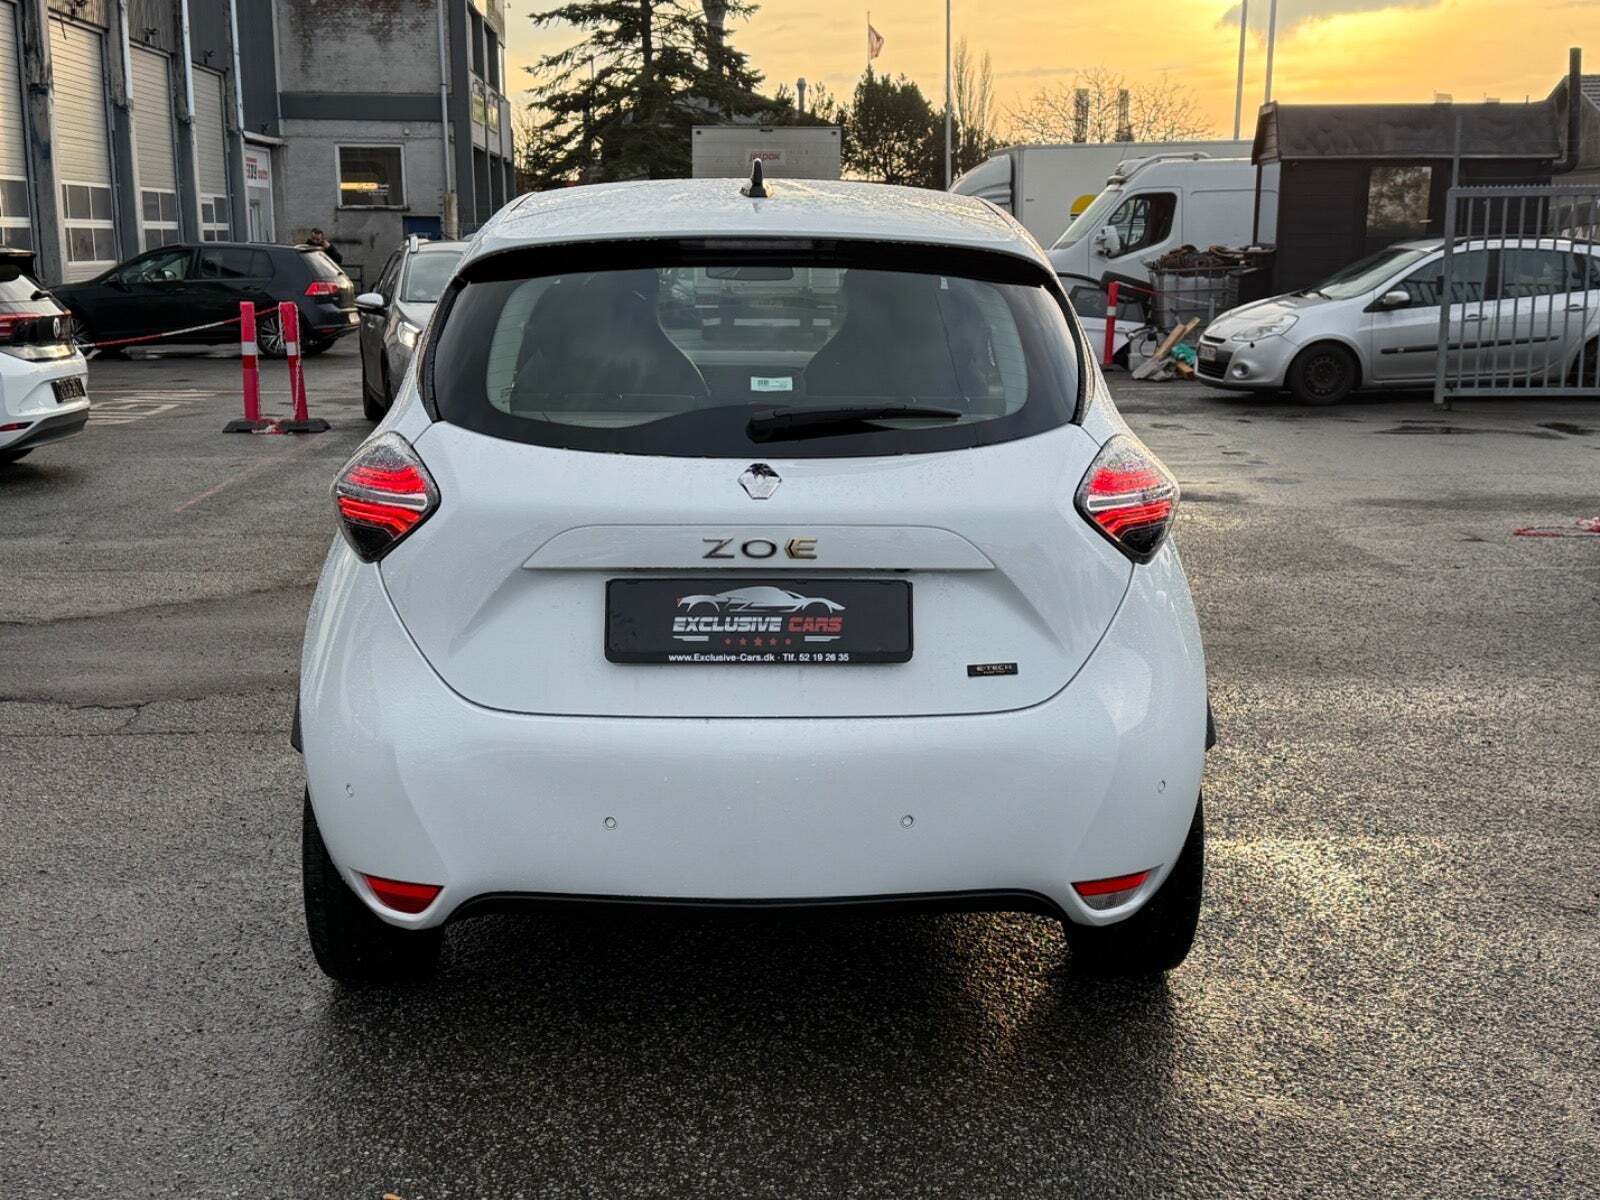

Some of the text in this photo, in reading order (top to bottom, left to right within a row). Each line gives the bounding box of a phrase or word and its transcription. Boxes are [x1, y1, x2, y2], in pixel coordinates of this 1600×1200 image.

[702, 537, 818, 559] ZOE
[672, 616, 844, 632] EXCLUSIVE CARS
[668, 653, 849, 662] www.Exclusive-Cars.dk Tlf. 52 19 26 35
